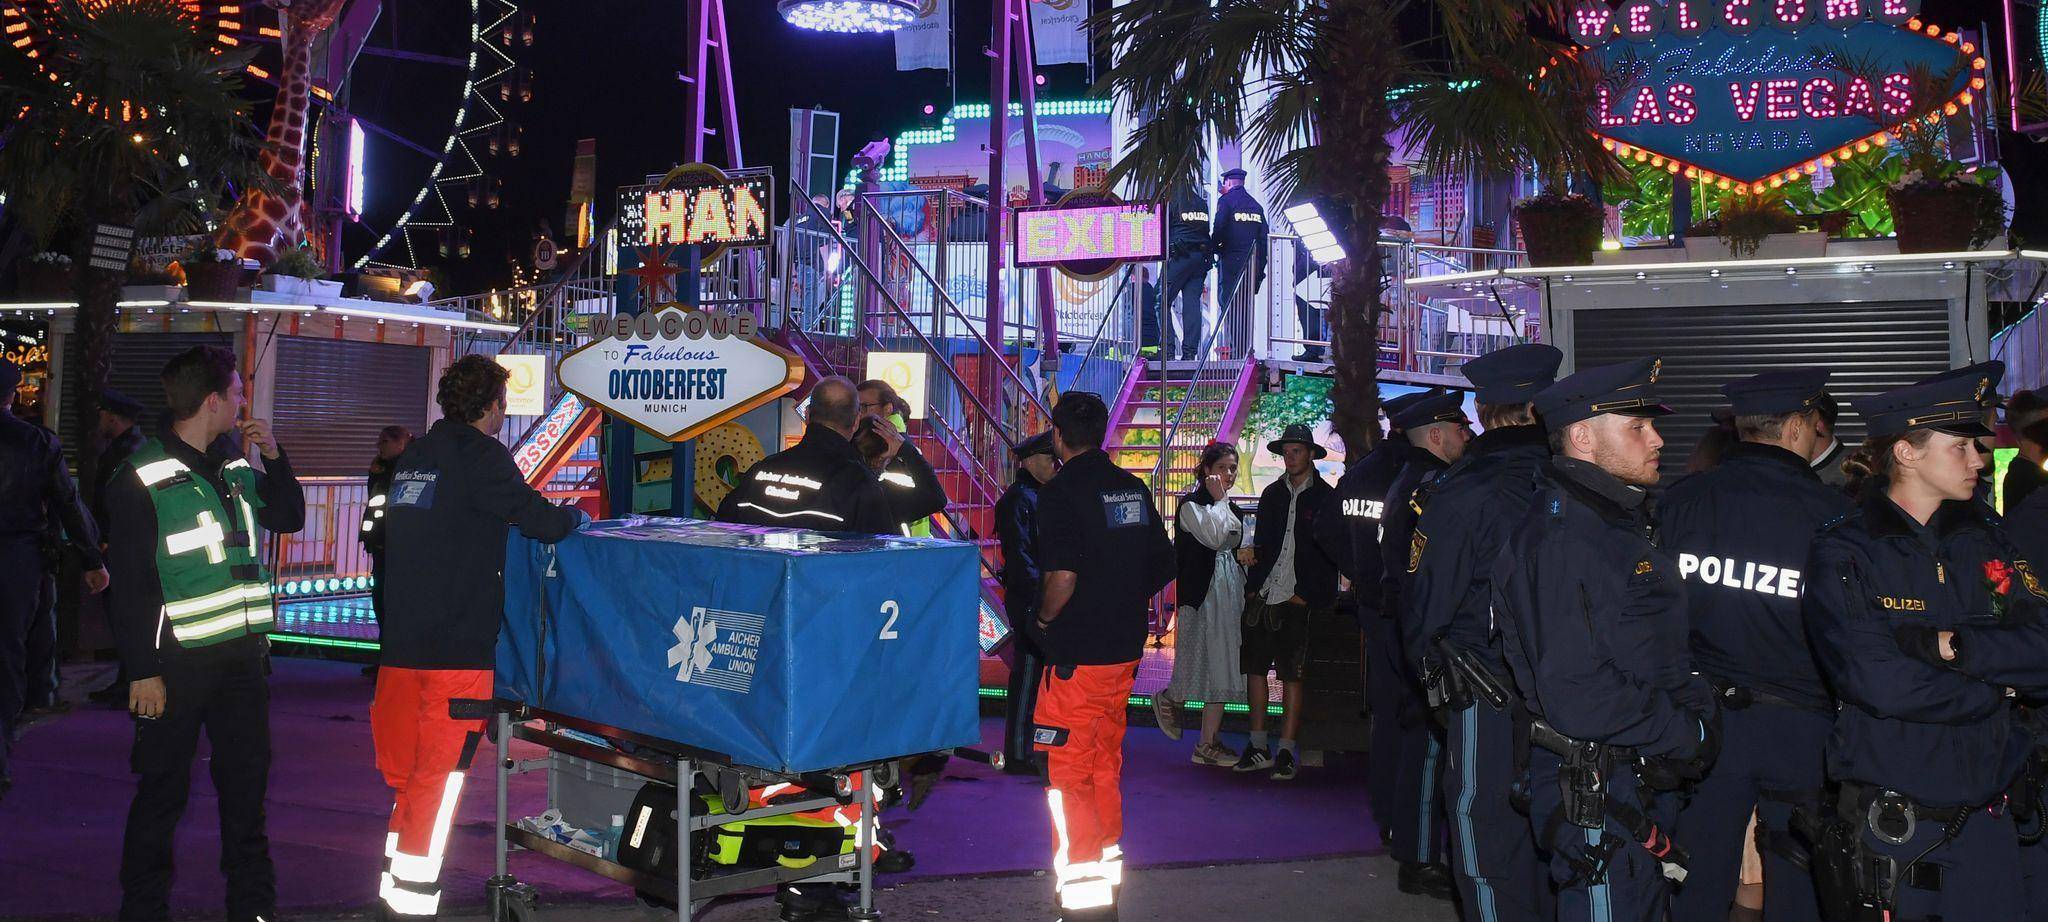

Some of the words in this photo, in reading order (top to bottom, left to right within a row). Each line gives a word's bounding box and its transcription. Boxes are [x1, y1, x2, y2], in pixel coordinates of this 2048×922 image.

[1576, 0, 1909, 36] WELCOME
[1618, 59, 1650, 80] TO
[1657, 46, 1836, 85] Fabulous
[1597, 82, 1697, 126] LAS
[1728, 72, 1913, 122] VEGAS
[1685, 130, 1814, 152] NEVADA
[645, 185, 765, 244] HAN
[1027, 212, 1150, 257] EXIT
[593, 318, 749, 336] WELCOME
[604, 351, 619, 360] TO
[624, 344, 720, 365] Fabulous
[609, 368, 727, 400] OKTOBERFEST
[644, 404, 687, 413] MUNICH
[412, 470, 436, 481] Service
[1103, 493, 1126, 503] Medical
[545, 543, 557, 577] 2
[1678, 552, 1806, 599] POLIZE
[879, 600, 899, 640] 2
[710, 643, 758, 660] AMBULANZ
[728, 631, 761, 647] AICHER
[728, 659, 755, 674] UNION
